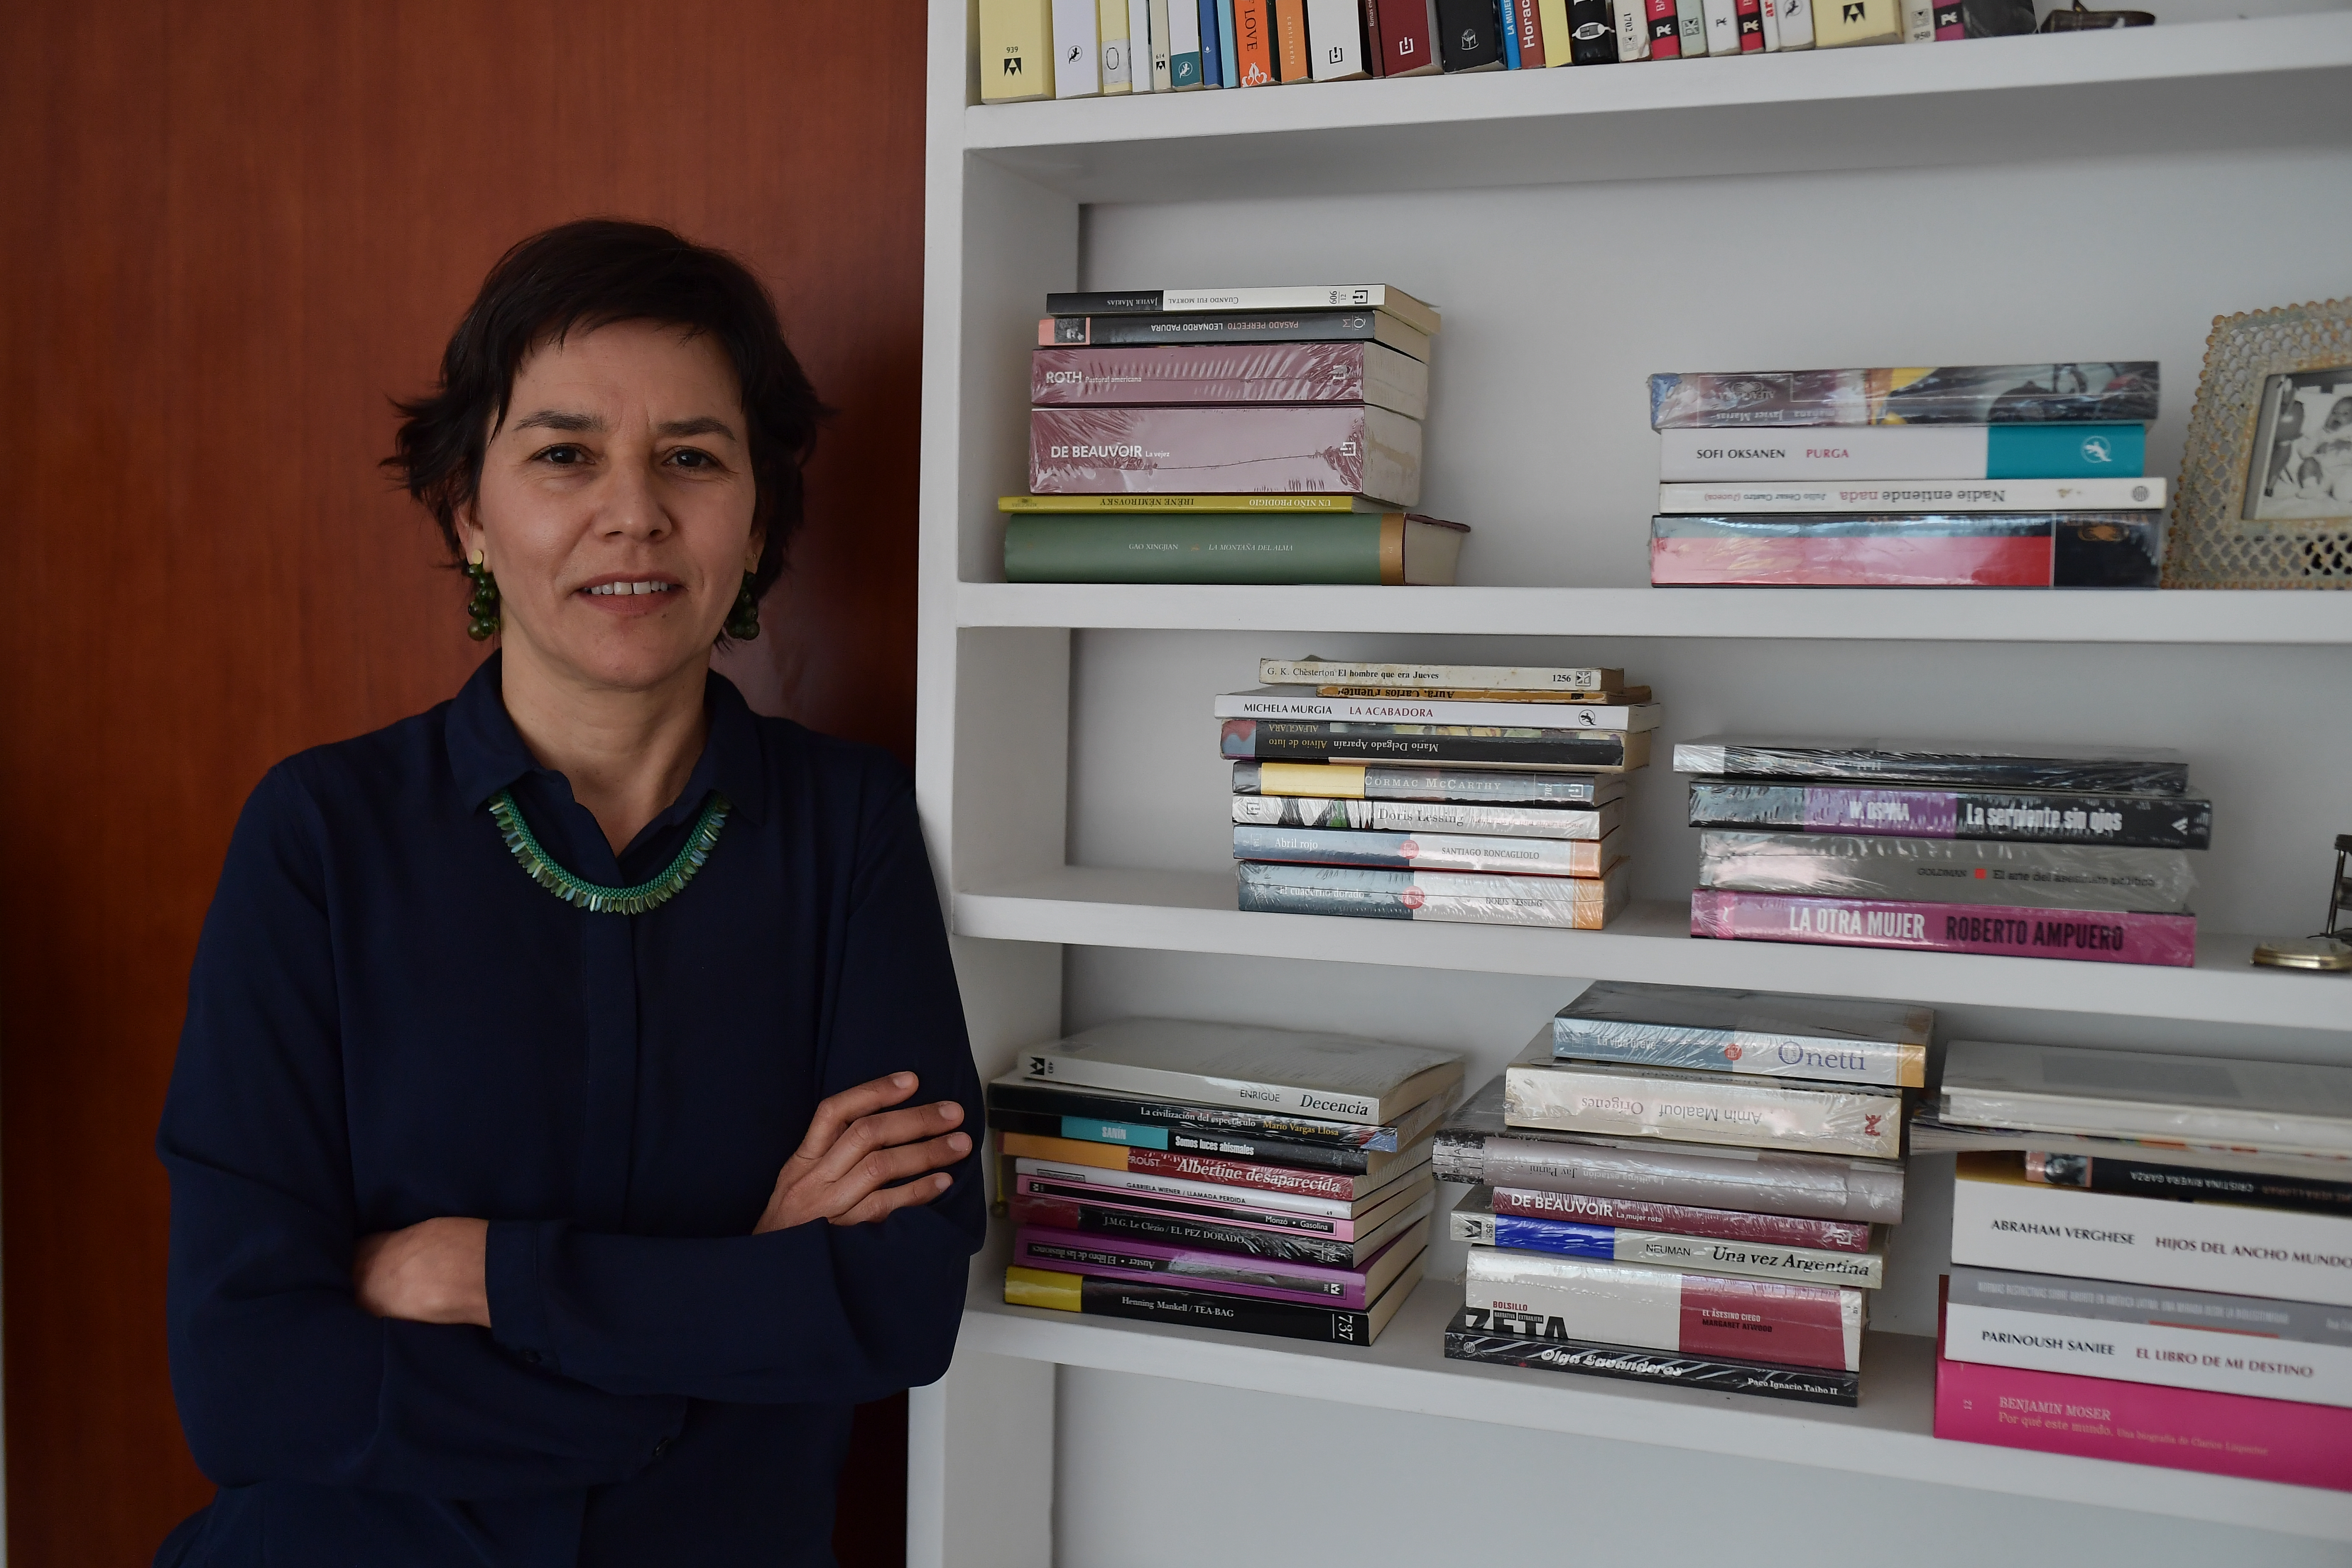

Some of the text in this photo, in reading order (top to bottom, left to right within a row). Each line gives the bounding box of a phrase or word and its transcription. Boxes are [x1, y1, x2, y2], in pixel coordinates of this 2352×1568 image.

[1508, 24, 1515, 35] LA
[1623, 13, 1632, 32] 1702
[1244, 9, 1258, 51] LOVE
[1135, 297, 1157, 306] JAVIER
[1046, 371, 1083, 384] ROTH
[1051, 446, 1068, 458] DE
[1073, 445, 1142, 458] BEAUVOIR
[1697, 449, 1849, 458] SOFI OKSANEN PURGA
[1100, 498, 1194, 508] IRÈNE NÉMIROVSKY
[1294, 499, 1316, 508] NIÑO
[1840, 490, 2006, 503] Nadie entiende nada
[1220, 543, 1255, 551] MONTAÑA
[1293, 668, 1334, 676] Chesterton
[1349, 670, 1378, 678] hombre
[1413, 671, 1439, 679] Jueves
[1552, 674, 1571, 682] 1256
[1244, 704, 1433, 717] MICHELA MURGIA LA ACABADORA
[1269, 724, 1318, 732] ALFAGUARA
[1269, 738, 1439, 752] Mario Delgado Aparaín Alivio de luto
[1365, 776, 1418, 787] CORMAC
[1379, 808, 1463, 826] Doris Lessing
[1966, 804, 2122, 834] La serpiente sin ojos
[1275, 838, 1318, 851] Abril rojo
[1442, 847, 1539, 859] SANTIAGO RONCAGLIOLO
[1993, 870, 2005, 879] El
[1280, 887, 1364, 898] El cuaderno dorado
[1790, 906, 2124, 951] LA OTRA MUJER ROBERTO AMPUERO
[1598, 1036, 1866, 1070] La vida Onetti
[1240, 1089, 1368, 1116] ENRIGUE Decencia
[1582, 1097, 1761, 1124] Amin Maalouf Orígenes
[1141, 1107, 1338, 1136] La civilización del Mario Vargas Llosa
[1102, 1126, 1126, 1140] SANÍN
[1175, 1135, 1254, 1155] Somos luces abismales
[1176, 1158, 1340, 1192] Albertine desaparecida
[1530, 1165, 1577, 1178] Jay Parini
[1127, 1182, 1246, 1203] GABRIELA WIENER LLAMADA PERDIDA
[1512, 1194, 1531, 1207] DE
[1535, 1198, 1612, 1217] BEAUVOIR
[1626, 1213, 1646, 1222] mujer
[1266, 1216, 1328, 1230] Monzó Gasolina
[1171, 1226, 1181, 1235] EL
[1185, 1229, 1200, 1237] PEZ
[1203, 1231, 1244, 1243] DORADO
[1992, 1220, 2352, 1268] ABRAHAM VERGHESE HIJOS DEL ANCHO MUNDO
[1129, 1259, 1155, 1269] Auster
[1647, 1244, 1869, 1276] NEUMAN Una vez Argentina
[1122, 1296, 1234, 1317] Henning Mankell TEA-BAG
[1493, 1301, 1527, 1311] BOLSILLO
[1494, 1312, 1515, 1320] NARRATIVA
[1519, 1315, 1543, 1323] EXTRANJERA
[1712, 1310, 1739, 1320] ASESINO
[1741, 1314, 1761, 1322] CIEGO
[1339, 1315, 1354, 1341] 737
[1702, 1319, 1772, 1333] MARGARET ATWOOD
[1982, 1331, 2314, 1377] PARINOUSH SANIEE EL LIBRO DE MI DESTINO
[1541, 1350, 1829, 1394] Olga Paco Ignacio Taibo
[2000, 1397, 2110, 1421] BENJAMIN MOSER
[1999, 1411, 2068, 1430] Por este
